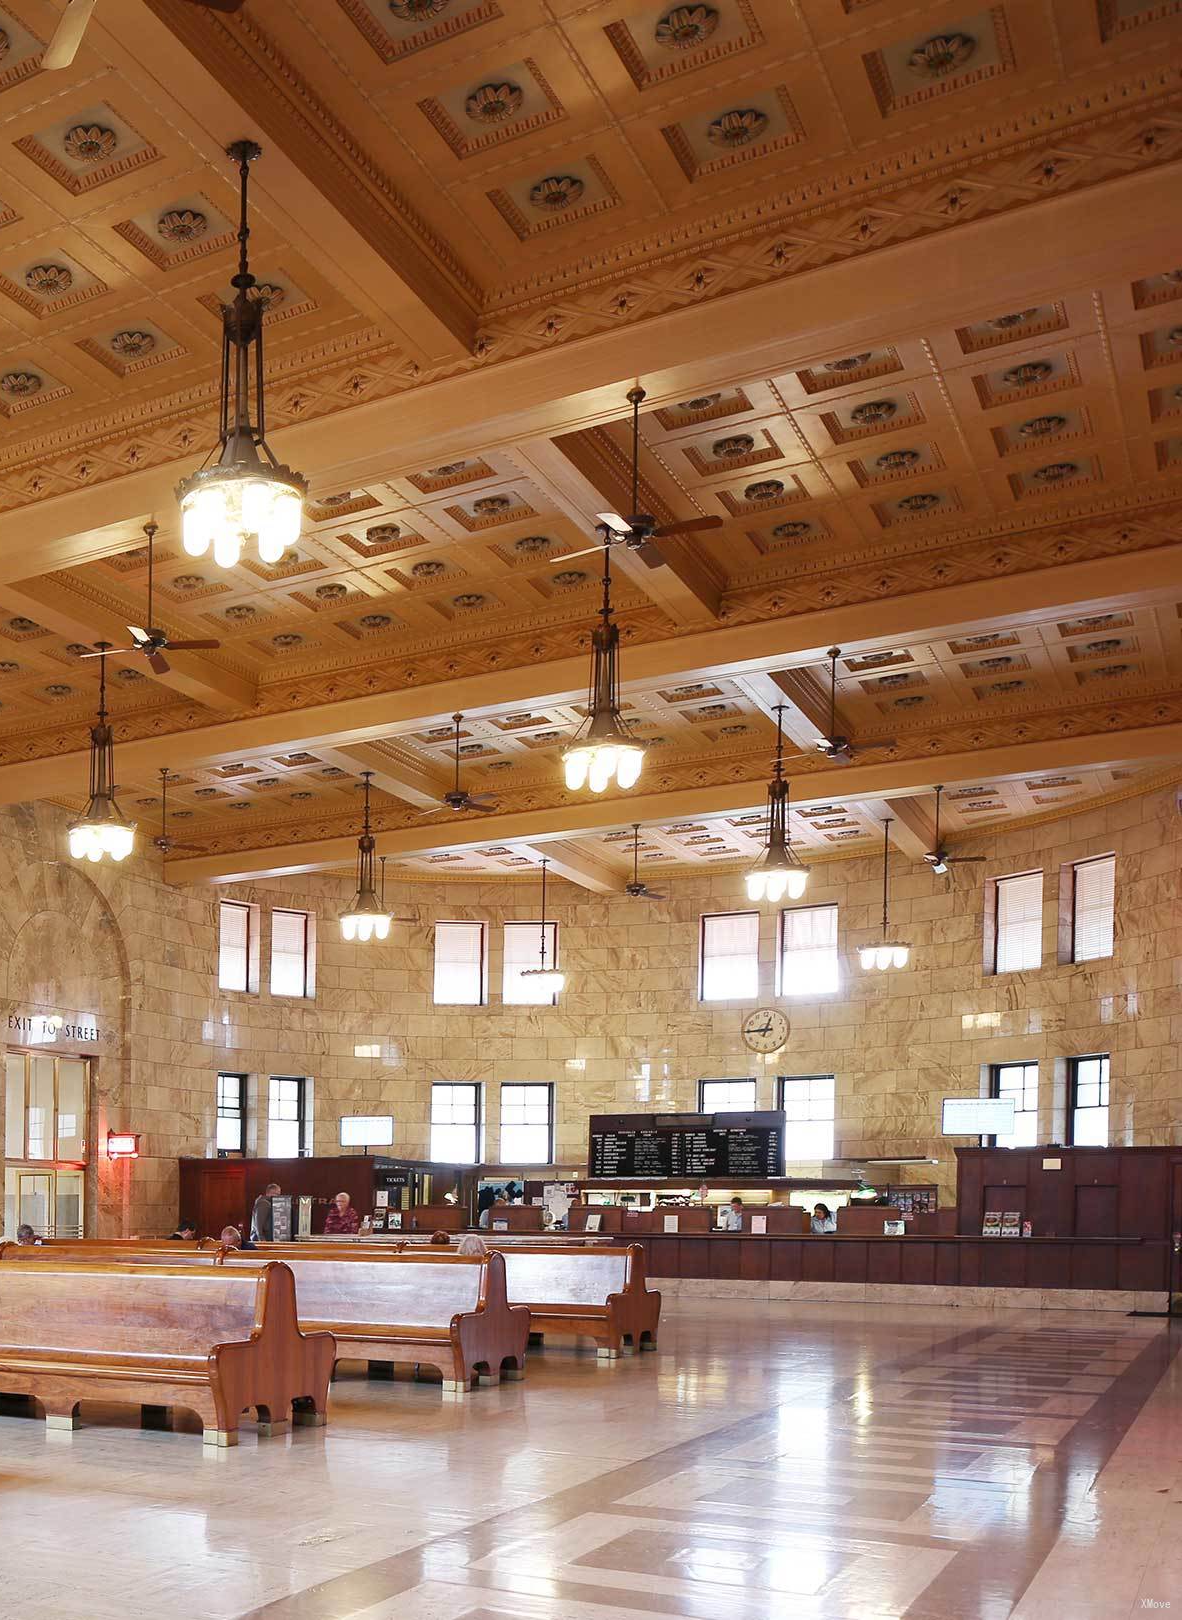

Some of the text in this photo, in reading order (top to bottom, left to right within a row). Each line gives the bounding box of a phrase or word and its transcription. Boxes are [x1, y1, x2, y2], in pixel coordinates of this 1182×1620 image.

[8, 1015, 101, 1041] EXIT TO STREET
